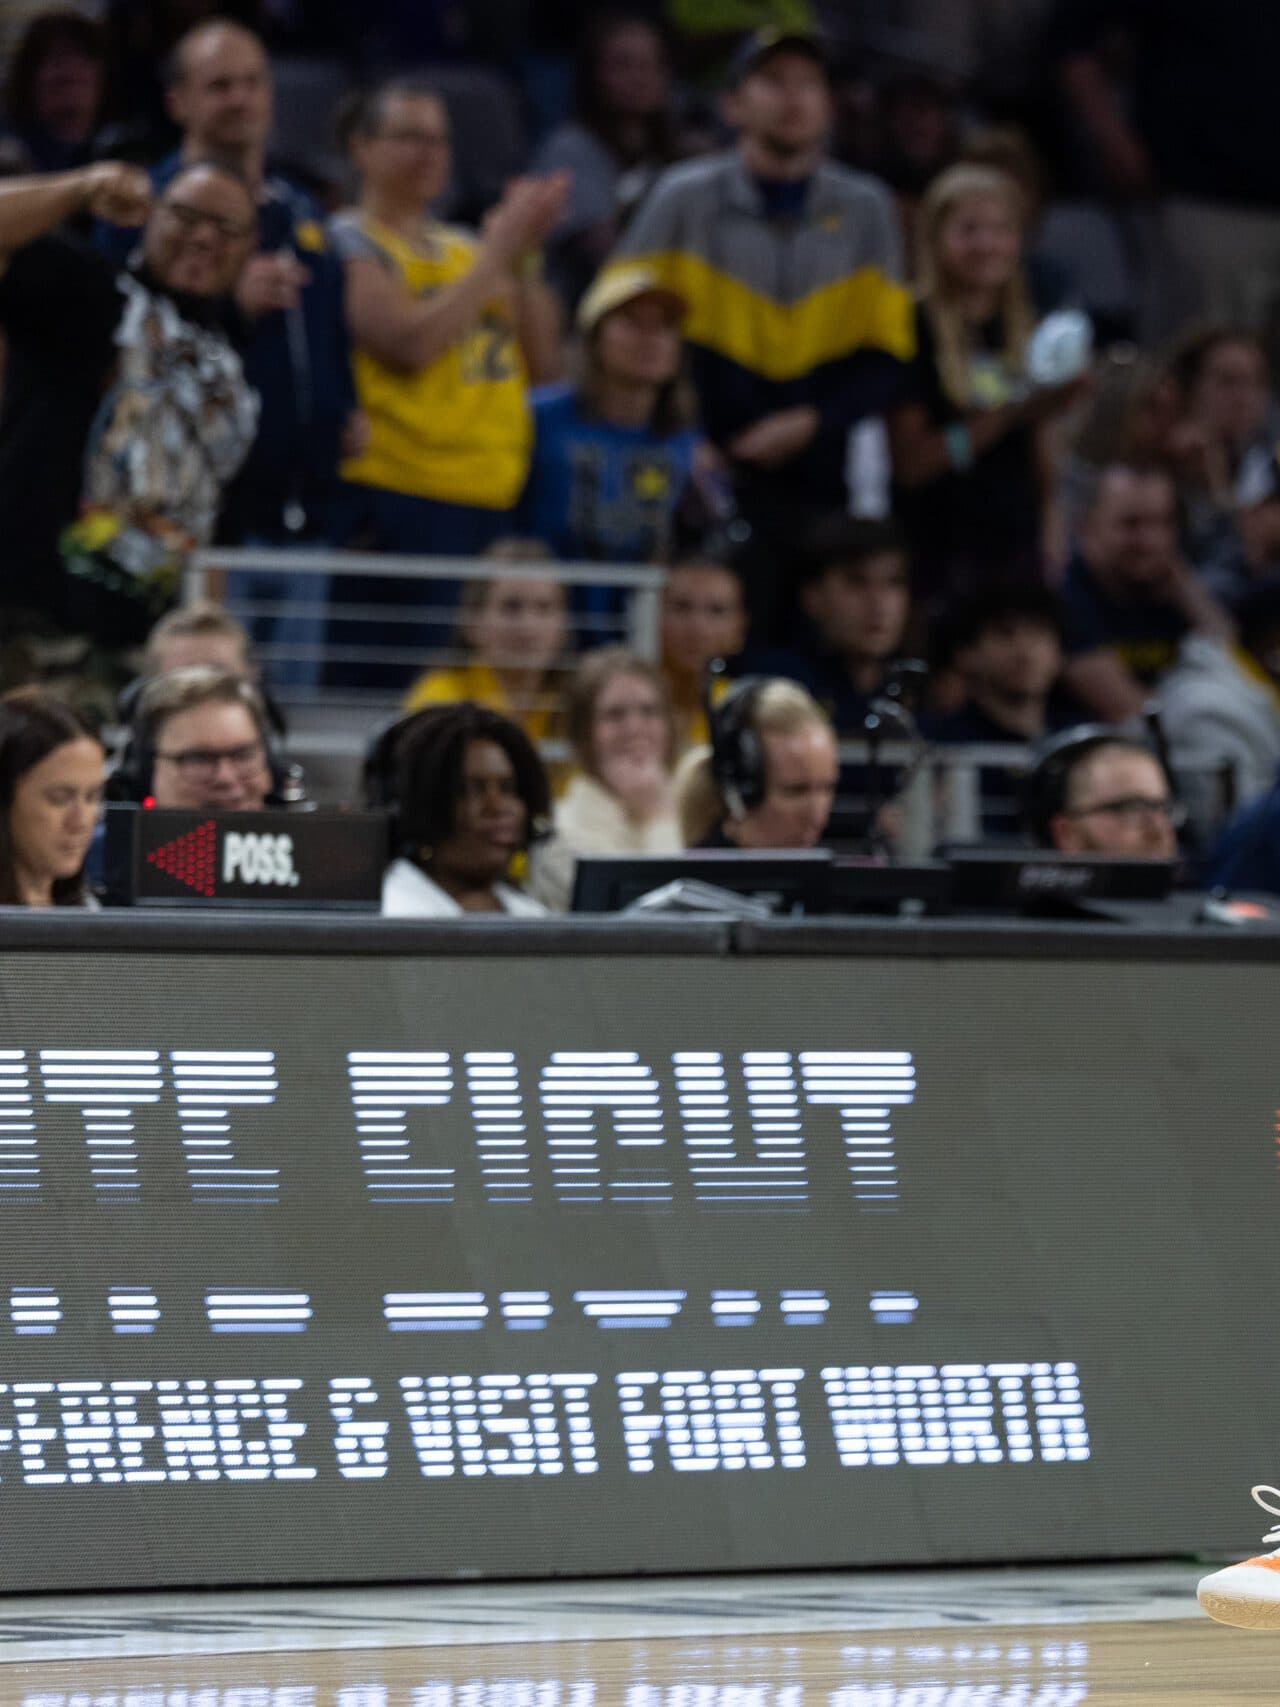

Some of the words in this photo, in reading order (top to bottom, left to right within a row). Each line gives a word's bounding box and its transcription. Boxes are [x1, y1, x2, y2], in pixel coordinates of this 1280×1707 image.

[223, 831, 300, 887] POSS.
[0, 1378, 317, 1485] ERENCE
[399, 1373, 599, 1477] VISIT
[616, 1368, 807, 1473] FORT
[820, 1362, 1091, 1468] WORTH
